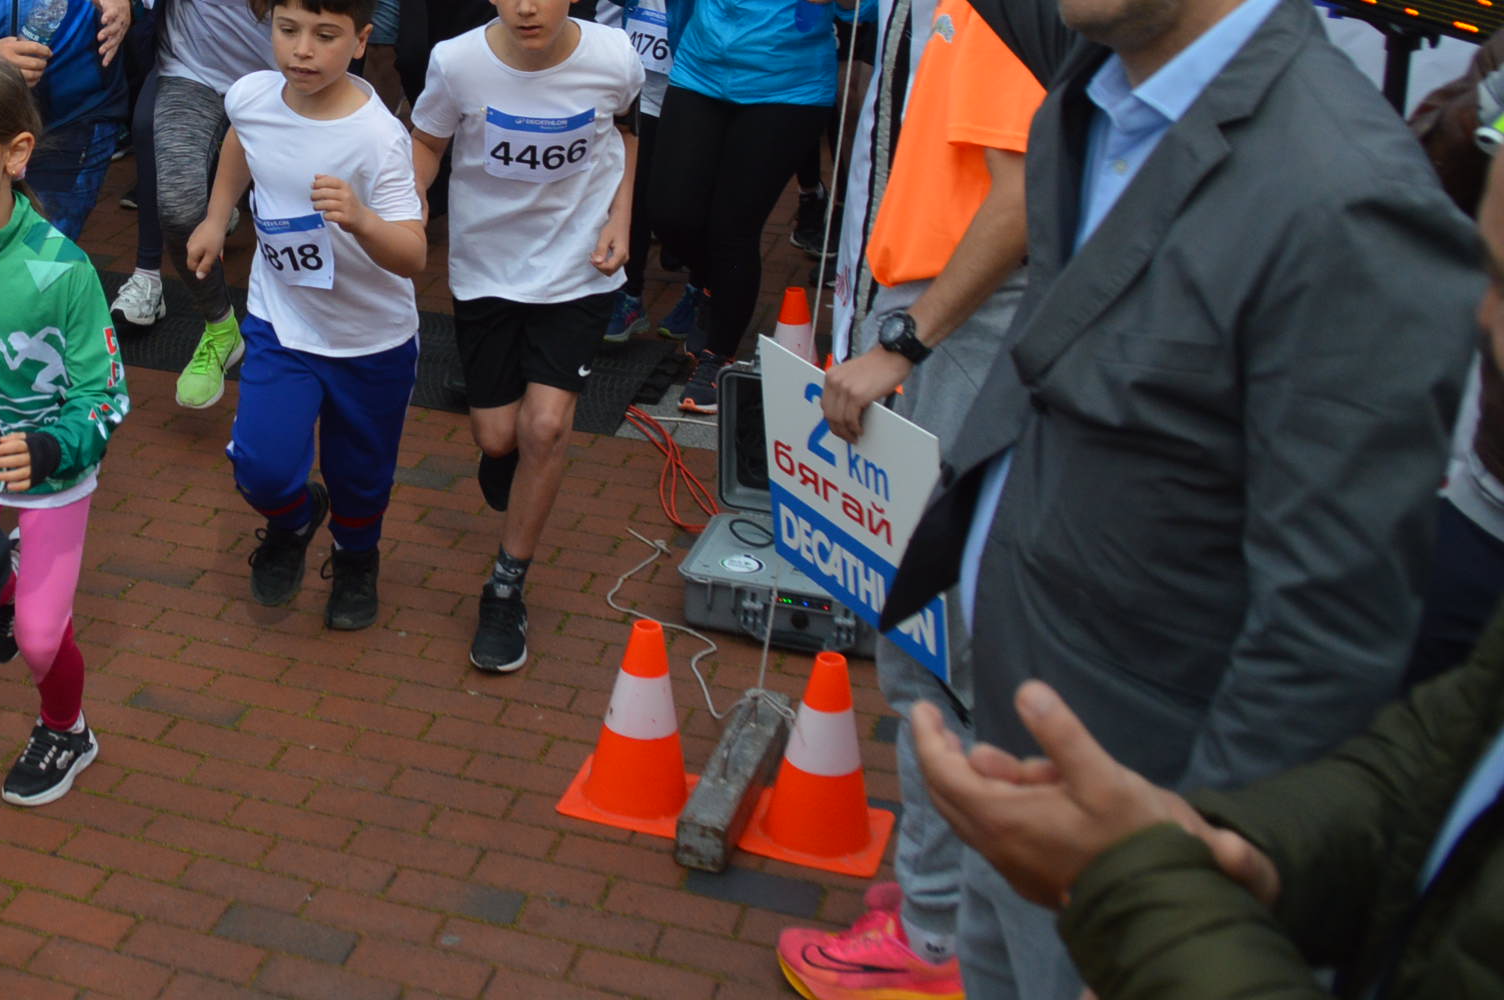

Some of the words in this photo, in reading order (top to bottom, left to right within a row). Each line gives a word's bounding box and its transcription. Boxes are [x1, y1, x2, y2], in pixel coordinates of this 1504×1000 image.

[489, 137, 589, 171] 4466
[261, 243, 324, 272] 818
[804, 382, 837, 468] 2
[846, 442, 891, 502] km
[773, 438, 894, 547] бягай
